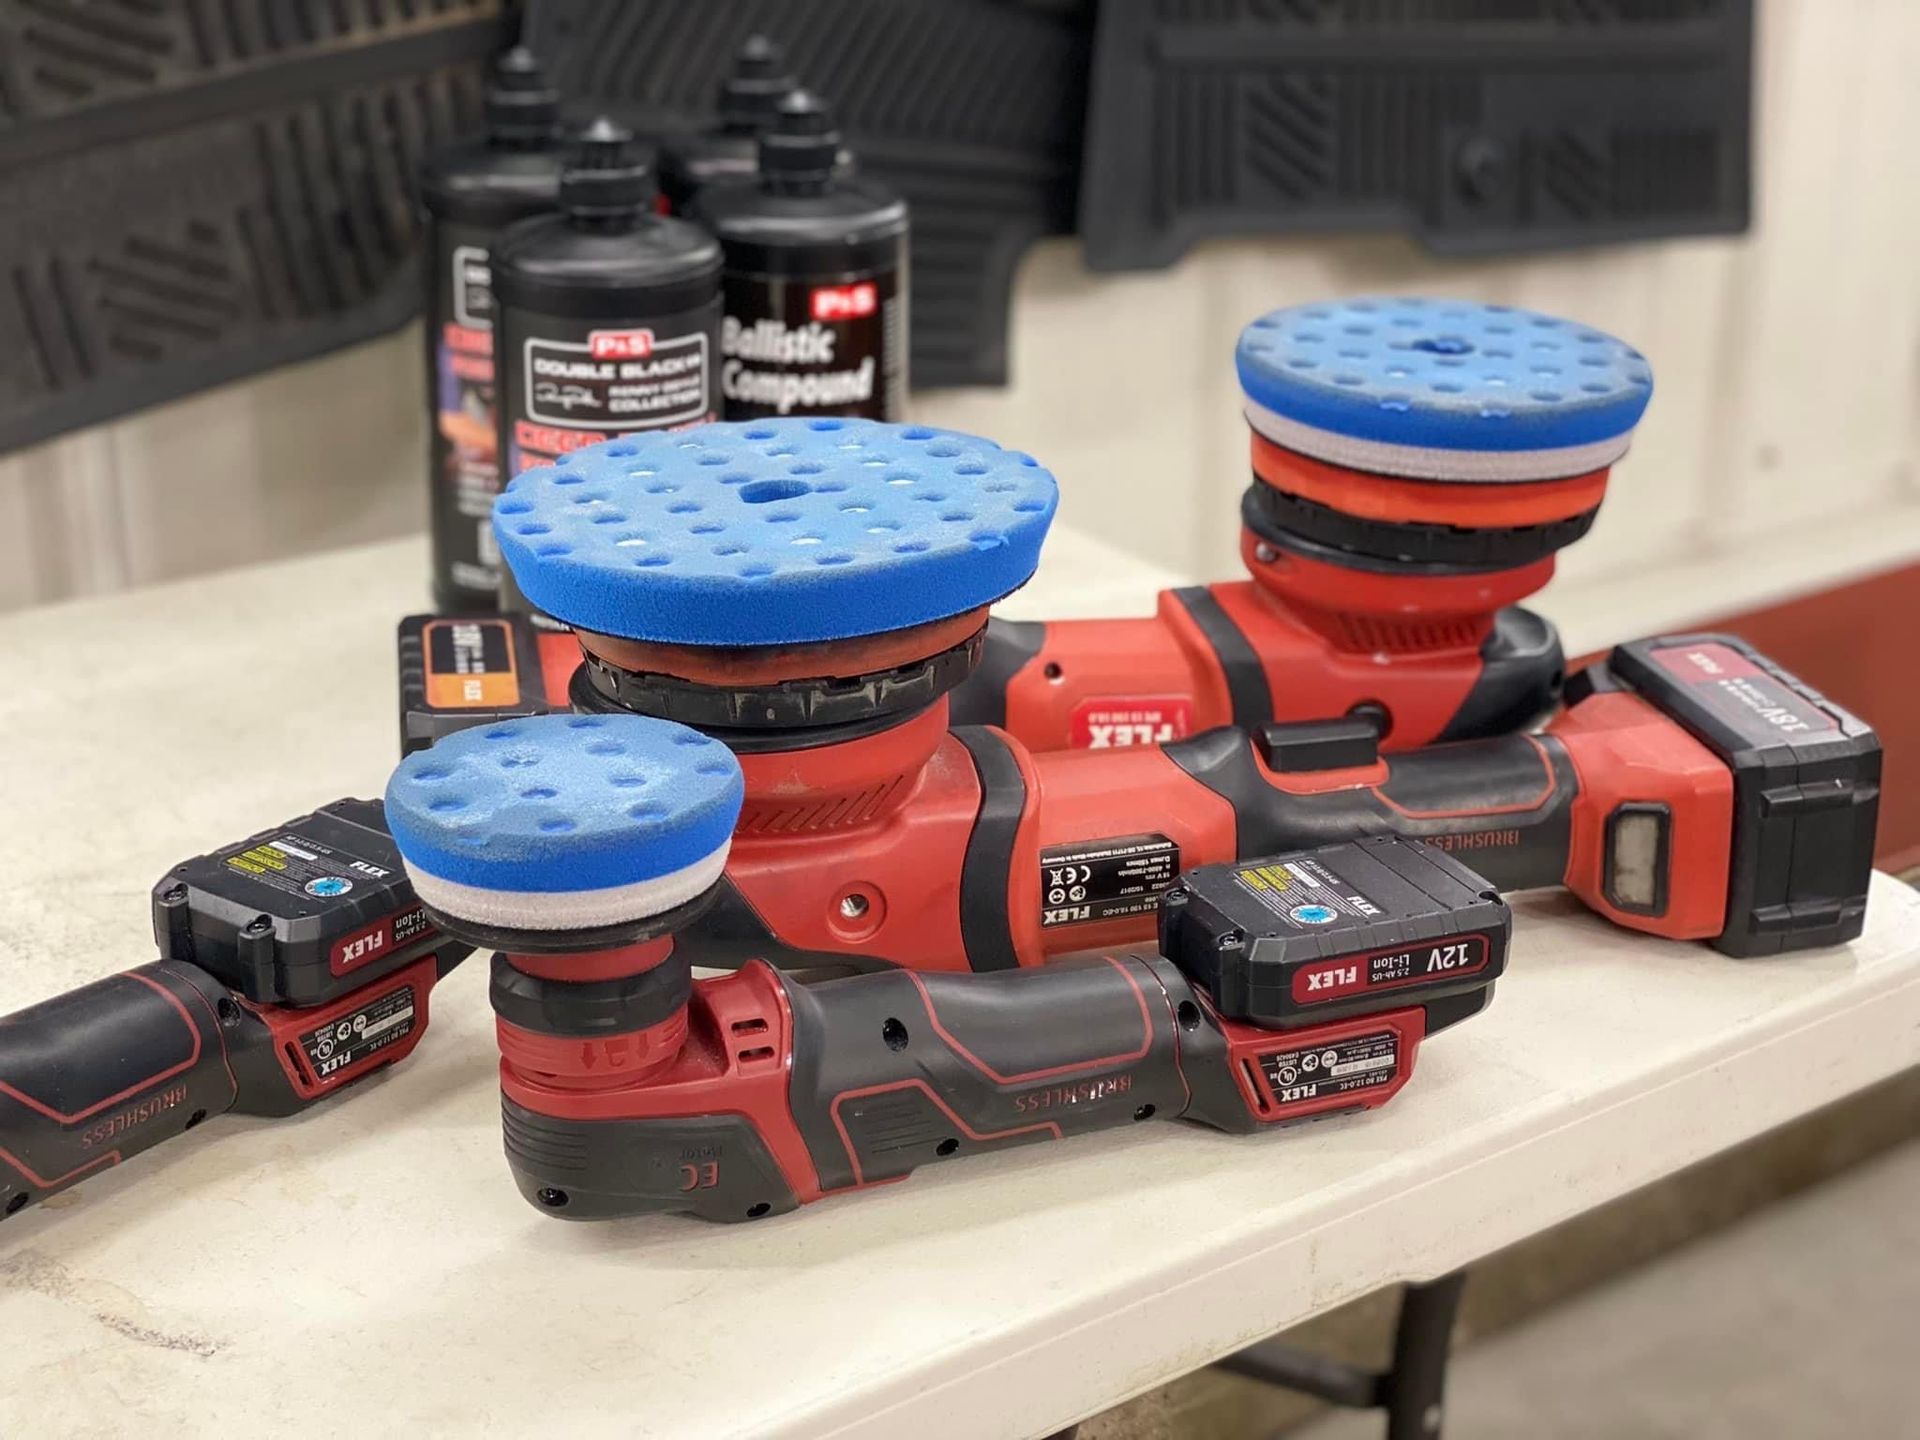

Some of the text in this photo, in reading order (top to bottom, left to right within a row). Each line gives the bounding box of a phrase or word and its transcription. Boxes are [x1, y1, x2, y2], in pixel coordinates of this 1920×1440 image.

[596, 336, 648, 357] P&S
[722, 316, 836, 364] Ballistic
[534, 357, 616, 380] DOUBLE
[722, 355, 875, 415] Compound
[1088, 722, 1173, 749] FLEX
[1424, 829, 1519, 851] BRUSHLESS
[349, 861, 391, 878] FLEX
[1043, 905, 1090, 925] FLEX
[1347, 895, 1382, 915] FLEX
[395, 907, 426, 929] Li-Ion
[342, 929, 383, 964] FLEX
[1426, 943, 1469, 972] 12V
[1373, 952, 1410, 969] Li-Ion
[1307, 965, 1357, 991] FLEX
[1372, 967, 1410, 982] 2.5 Ah-US
[320, 1051, 351, 1076] FLEX
[1015, 1074, 1132, 1113] BRUSHLESS
[1281, 1084, 1318, 1103] FLEX
[82, 1082, 187, 1150] BRUSHLESS
[680, 1160, 719, 1192] EC
